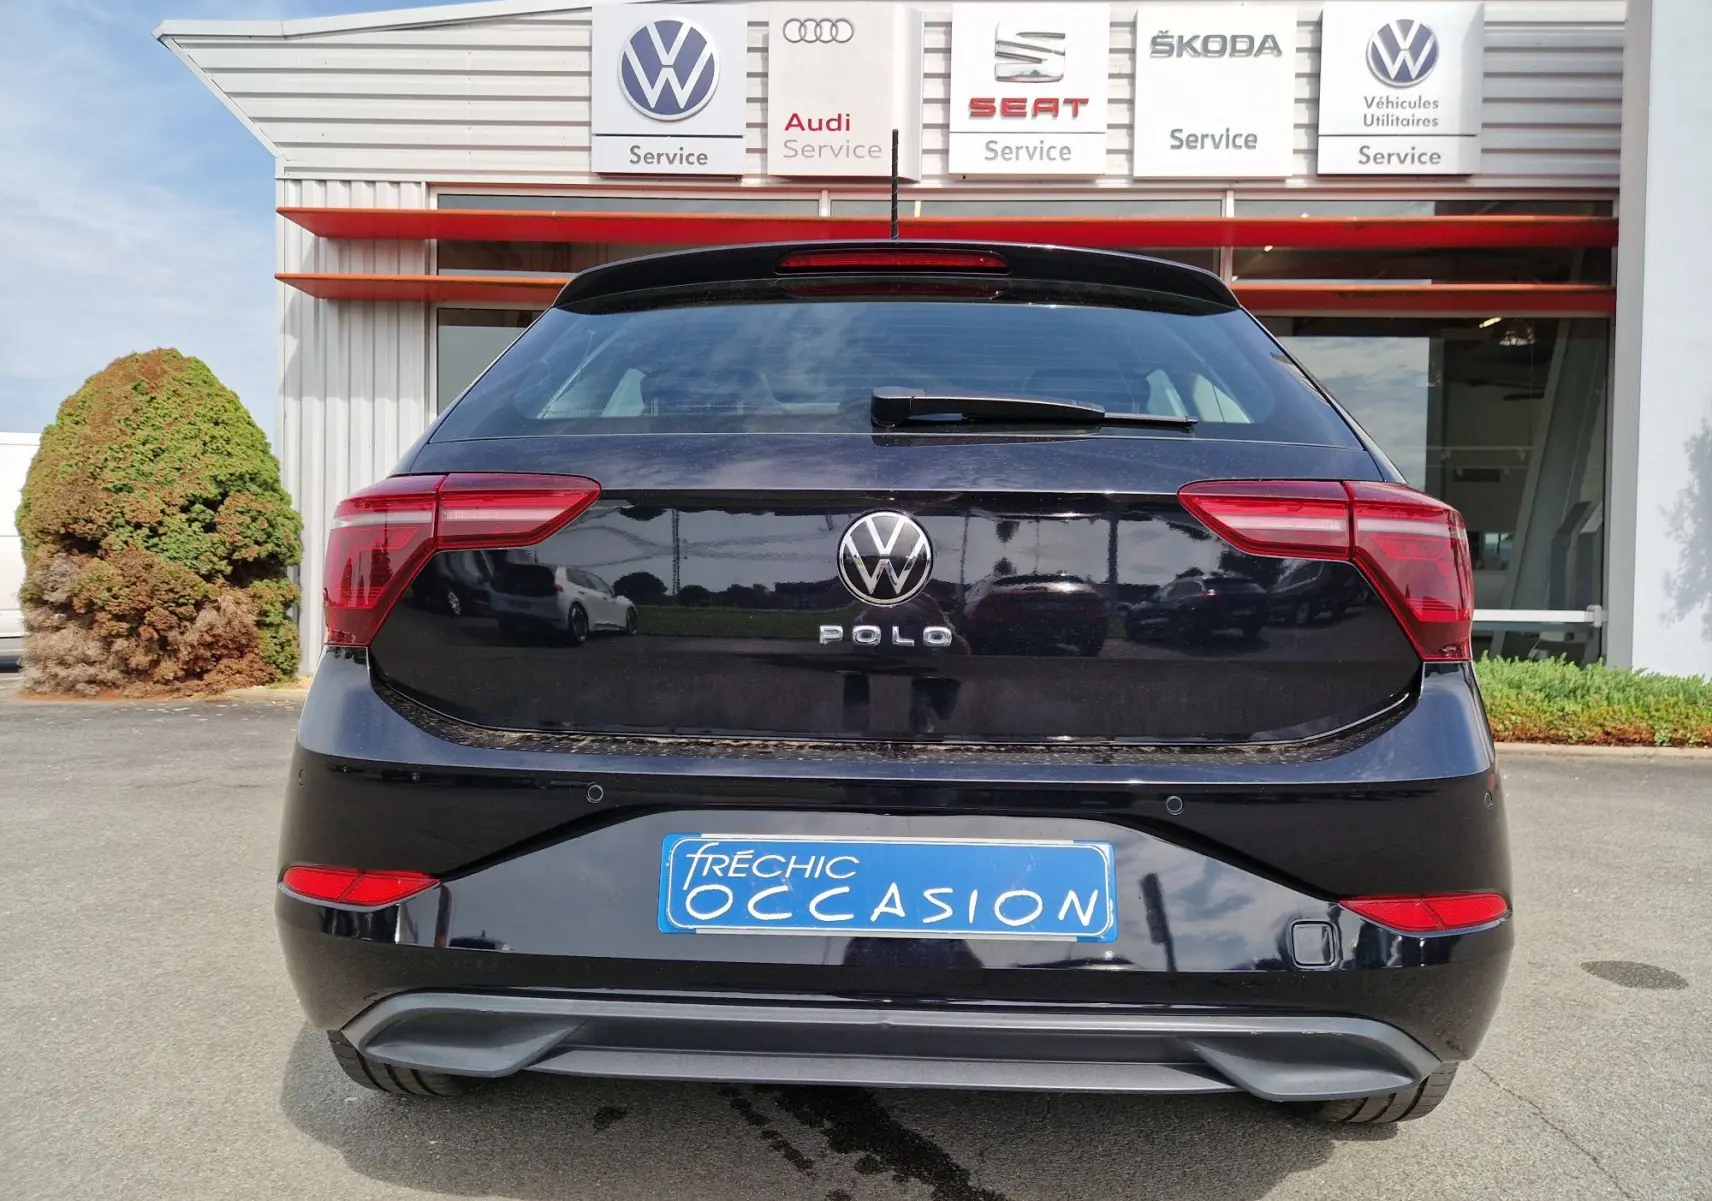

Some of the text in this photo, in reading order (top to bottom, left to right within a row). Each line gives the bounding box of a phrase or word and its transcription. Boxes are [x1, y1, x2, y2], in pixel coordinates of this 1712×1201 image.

[1150, 31, 1282, 58] ŠKODA
[969, 98, 1089, 118] SEAT
[1363, 95, 1439, 110] Véhicules
[784, 113, 851, 132] Audi
[1363, 113, 1439, 128] Utilitaires
[783, 140, 882, 159] Service
[1169, 128, 1258, 150] Service
[629, 145, 709, 166] Service
[984, 140, 1072, 162] Service
[1358, 145, 1442, 166] Service
[819, 625, 953, 647] POLO
[685, 882, 1098, 927] OCCASION
